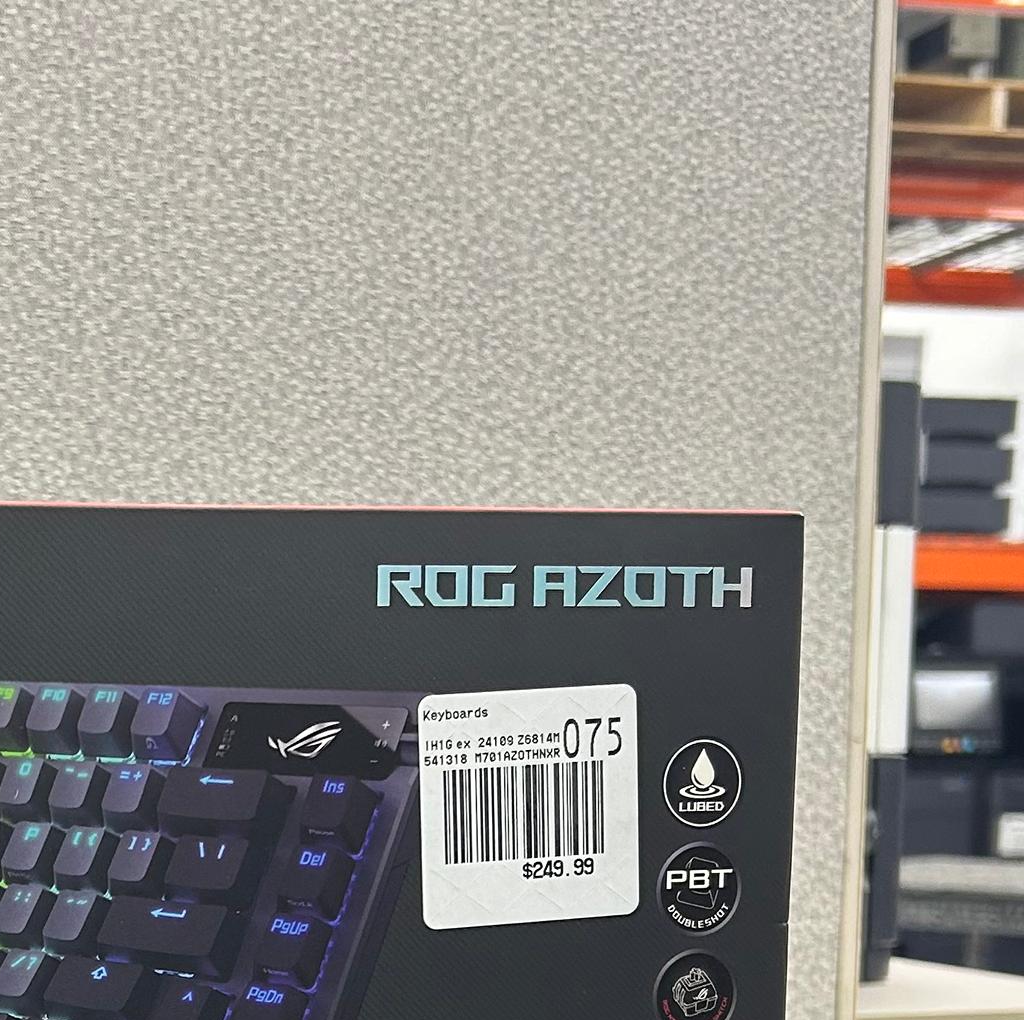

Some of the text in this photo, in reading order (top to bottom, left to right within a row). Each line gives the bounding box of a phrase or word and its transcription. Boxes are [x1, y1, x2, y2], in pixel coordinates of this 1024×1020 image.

[377, 564, 753, 608] ROG AZOTH
[41, 688, 67, 701] F10
[94, 690, 118, 703] F11
[147, 692, 173, 705] F12
[422, 707, 489, 722] Keyboards
[456, 740, 471, 749] ex
[478, 735, 514, 749] 24109
[563, 717, 623, 759] 075
[424, 754, 468, 767] 541318
[322, 779, 345, 794] Ins
[678, 801, 725, 812] LUBED
[25, 827, 40, 840] P
[299, 851, 326, 866] Del
[522, 857, 595, 880] $249.99
[666, 868, 734, 890] PBT
[667, 902, 730, 930] DOUBLESHOT
[271, 918, 310, 936] PgUp
[247, 986, 284, 1004] PgDn
